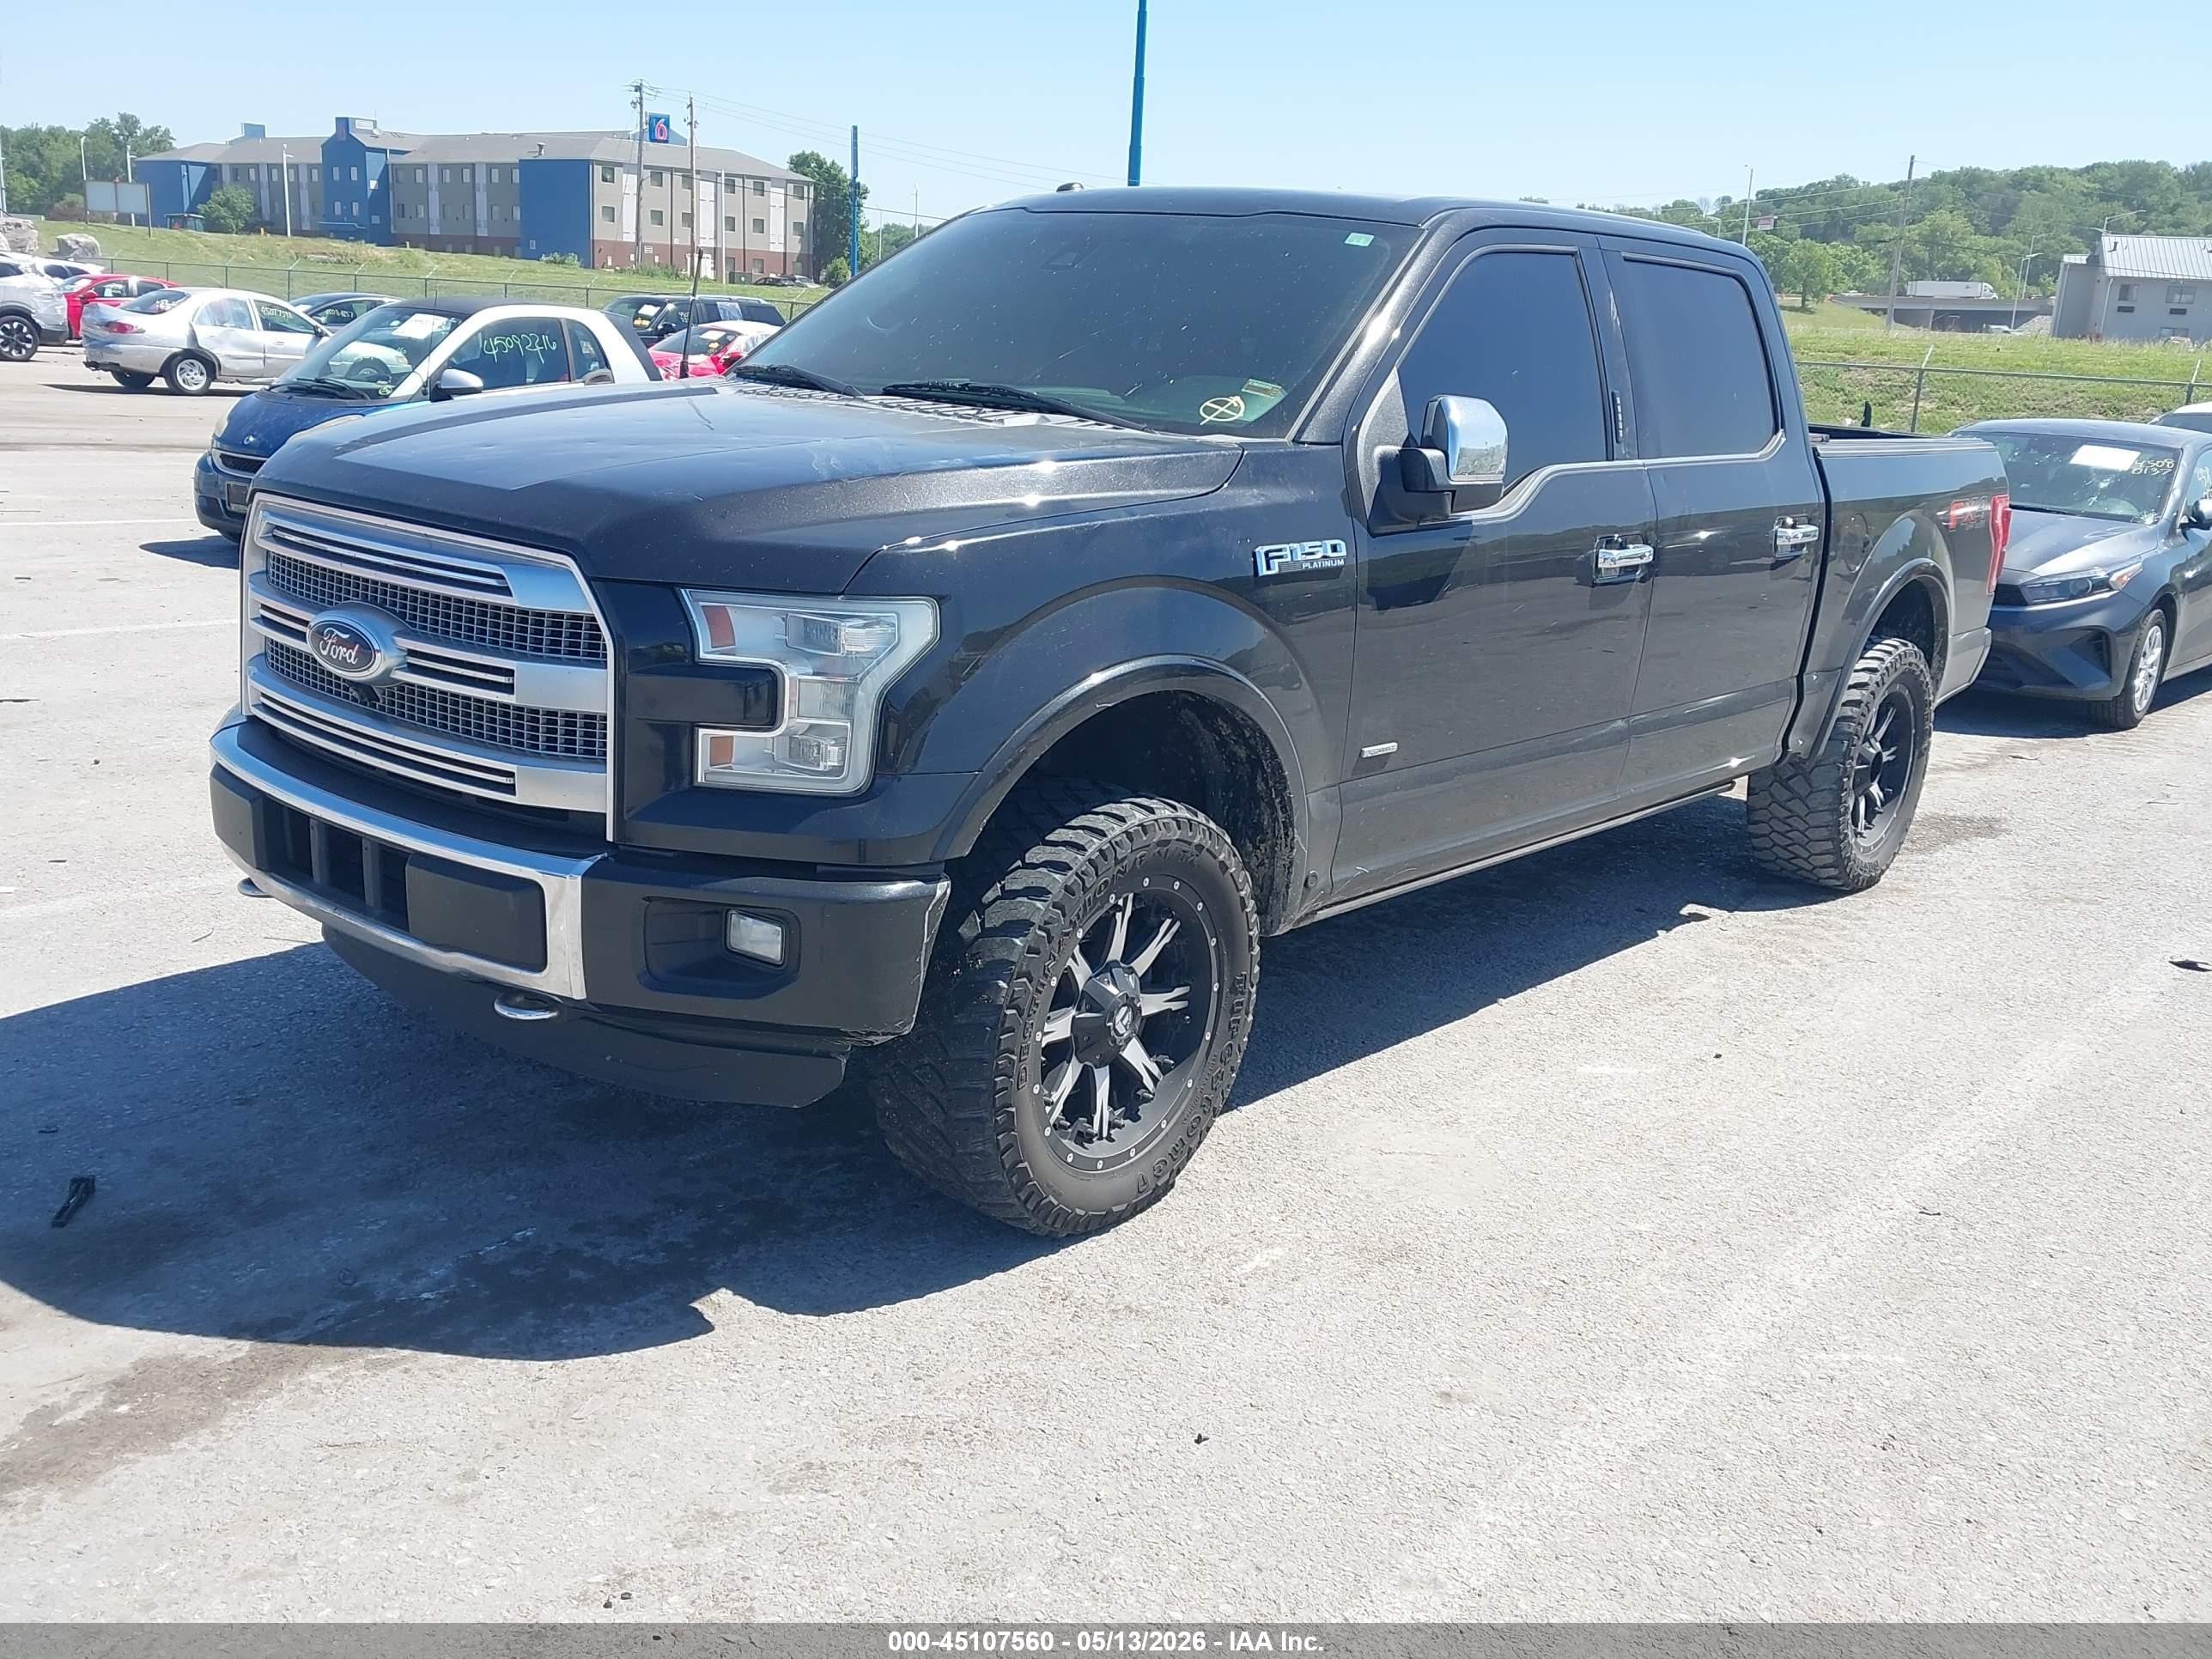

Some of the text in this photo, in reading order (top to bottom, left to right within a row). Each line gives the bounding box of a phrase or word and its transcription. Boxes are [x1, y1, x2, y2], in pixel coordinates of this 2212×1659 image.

[655, 118, 667, 140] 6
[2135, 459, 2175, 469] 4508
[2131, 467, 2172, 476] 0137
[1302, 559, 1345, 569] PLATINUM
[319, 627, 360, 665] Ford
